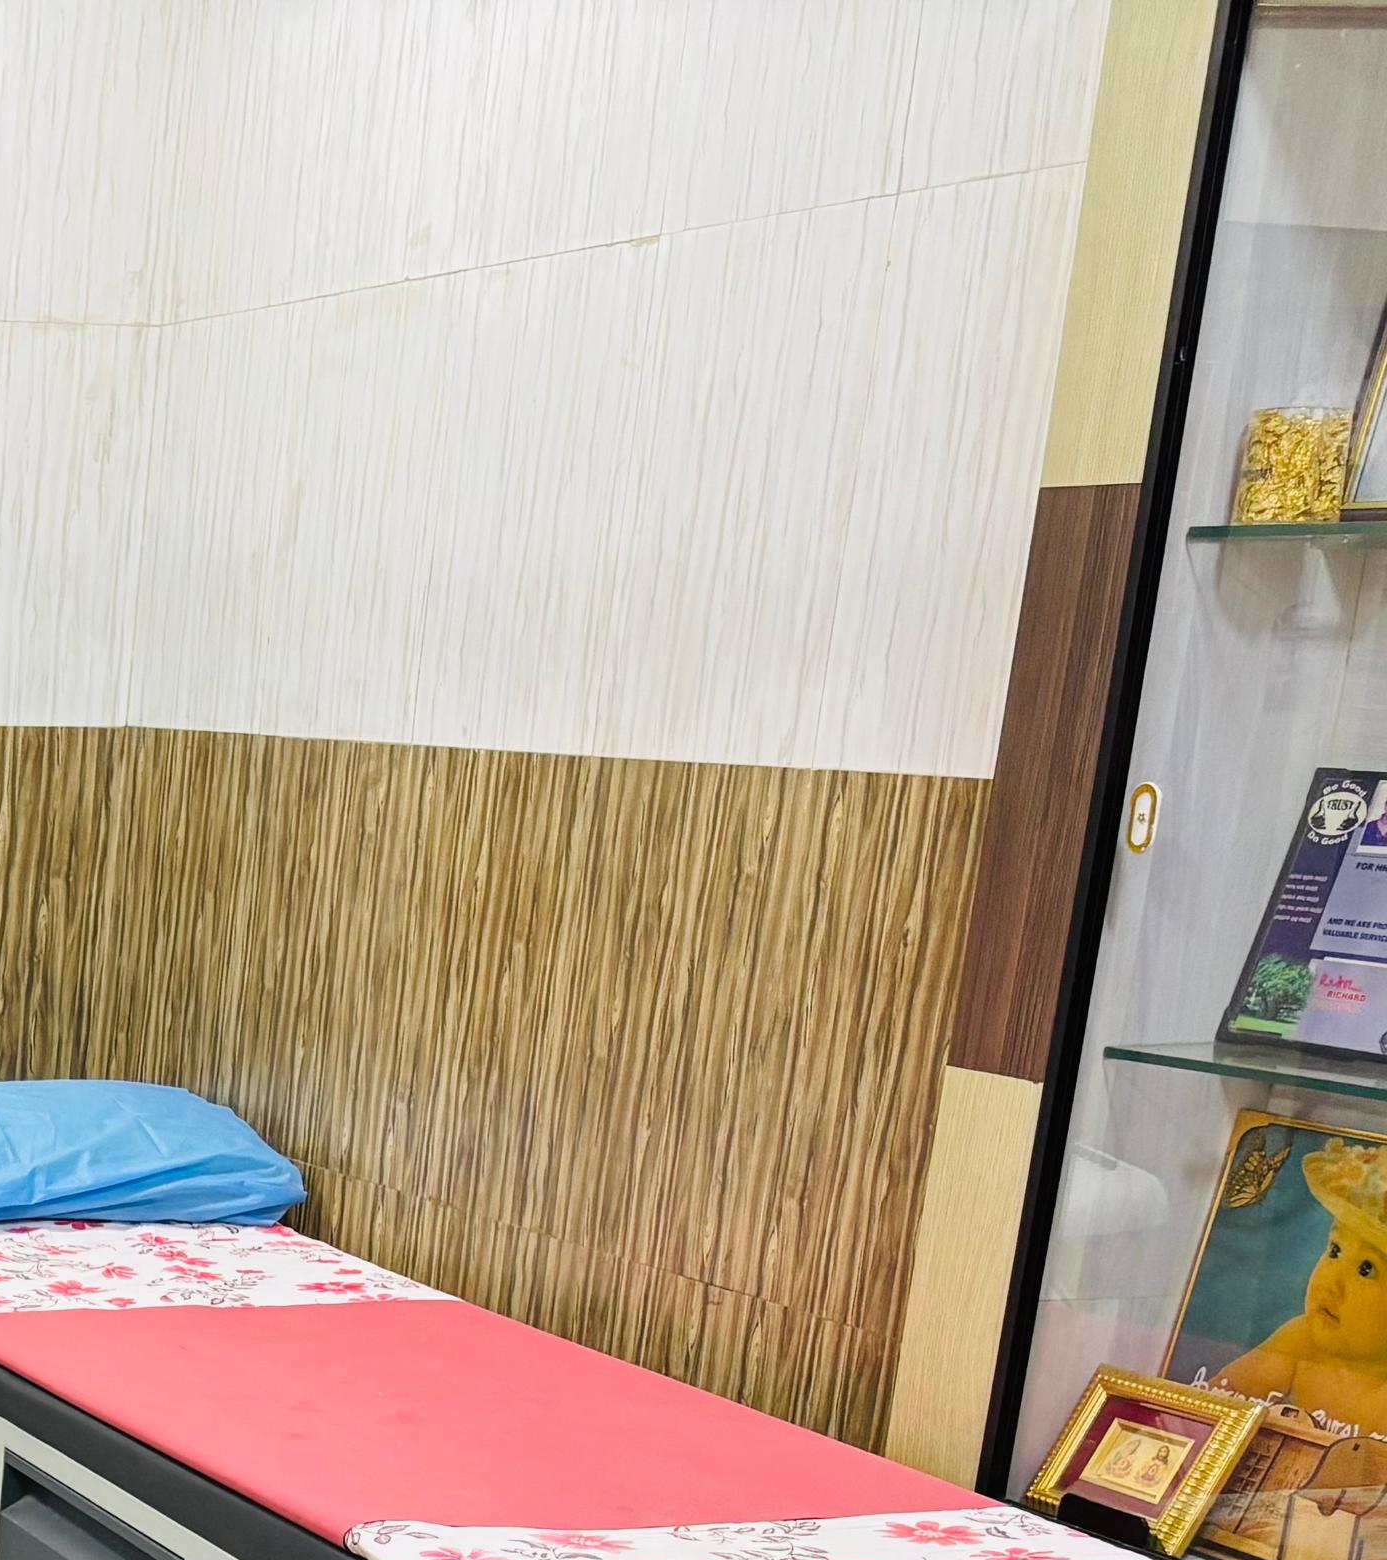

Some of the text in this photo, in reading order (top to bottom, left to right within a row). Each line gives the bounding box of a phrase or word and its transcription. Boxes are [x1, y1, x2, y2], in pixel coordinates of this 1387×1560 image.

[1341, 780, 1367, 797] Good
[1326, 799, 1354, 811] TRUST
[1307, 831, 1349, 845] Do Good
